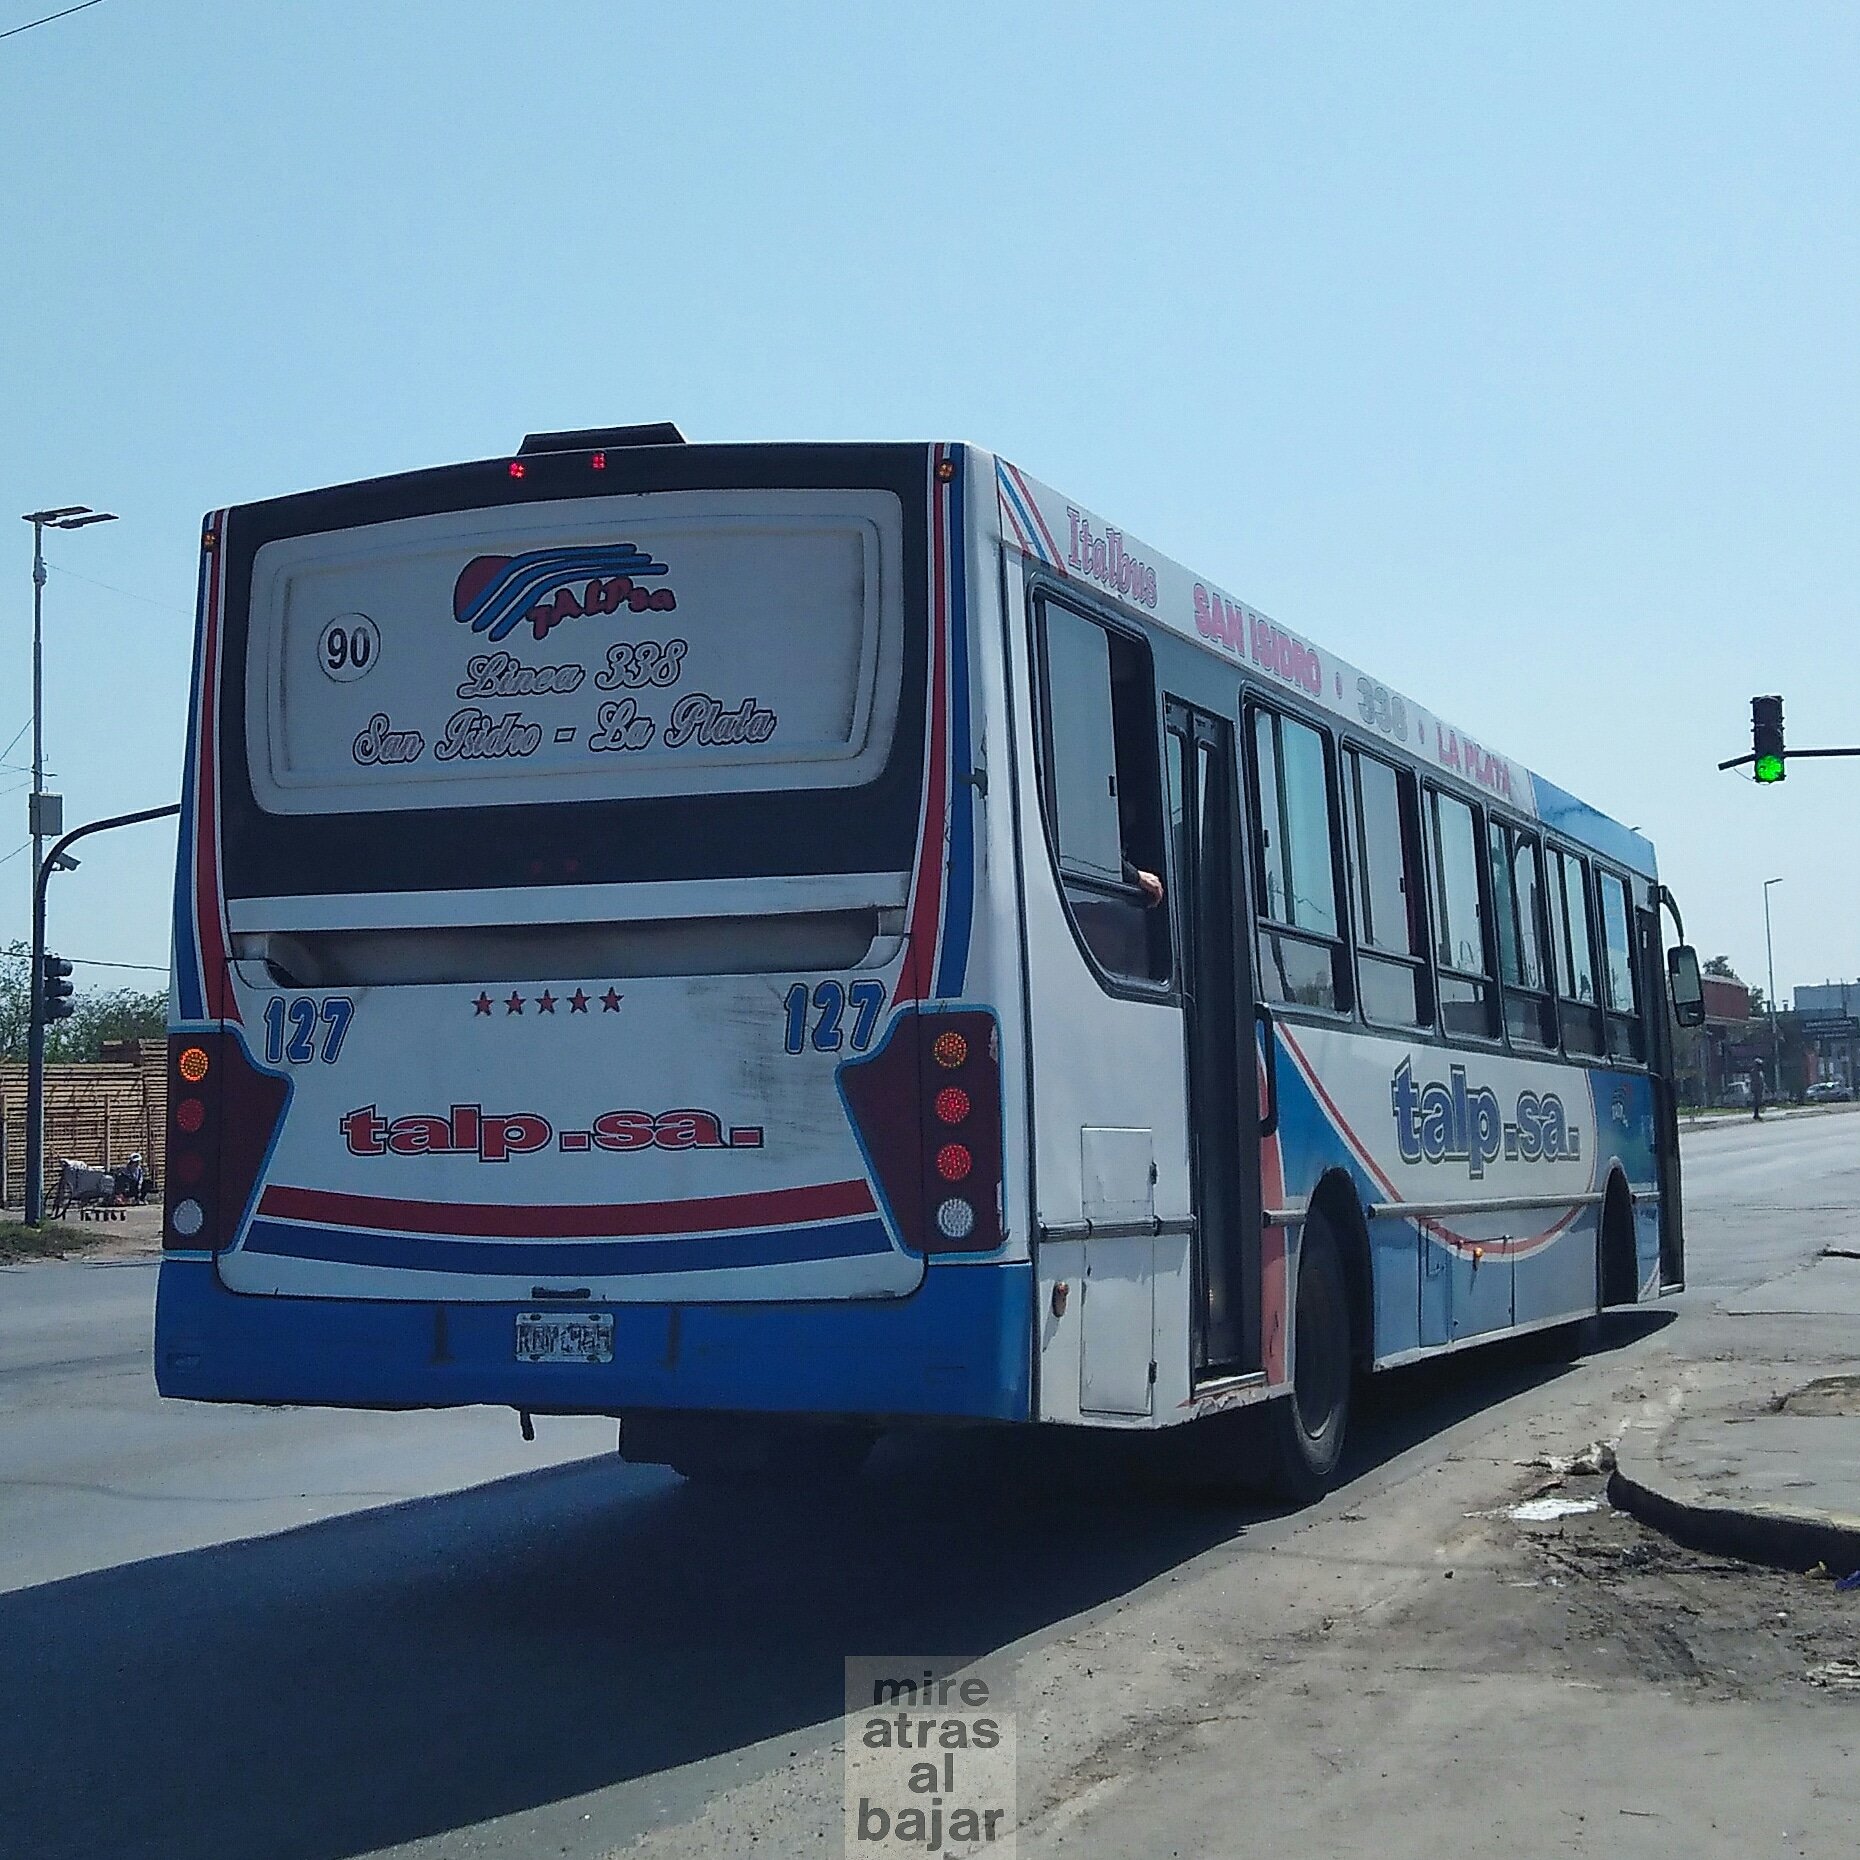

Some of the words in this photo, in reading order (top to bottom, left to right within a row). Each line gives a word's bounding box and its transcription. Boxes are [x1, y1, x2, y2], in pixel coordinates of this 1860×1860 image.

[1067, 506, 1157, 608] Italbus
[326, 627, 370, 668] 90
[457, 652, 585, 699] Linea
[595, 638, 688, 690] 338
[353, 713, 424, 766] San
[435, 707, 542, 761] Isidro
[589, 697, 654, 752] La
[664, 692, 777, 748] Plata
[1194, 583, 1245, 658] SAN
[1249, 613, 1322, 697] ISIDRO
[1435, 721, 1461, 773] LA
[1463, 737, 1513, 802] PLATA
[264, 997, 354, 1064] 127
[784, 981, 887, 1054] 127
